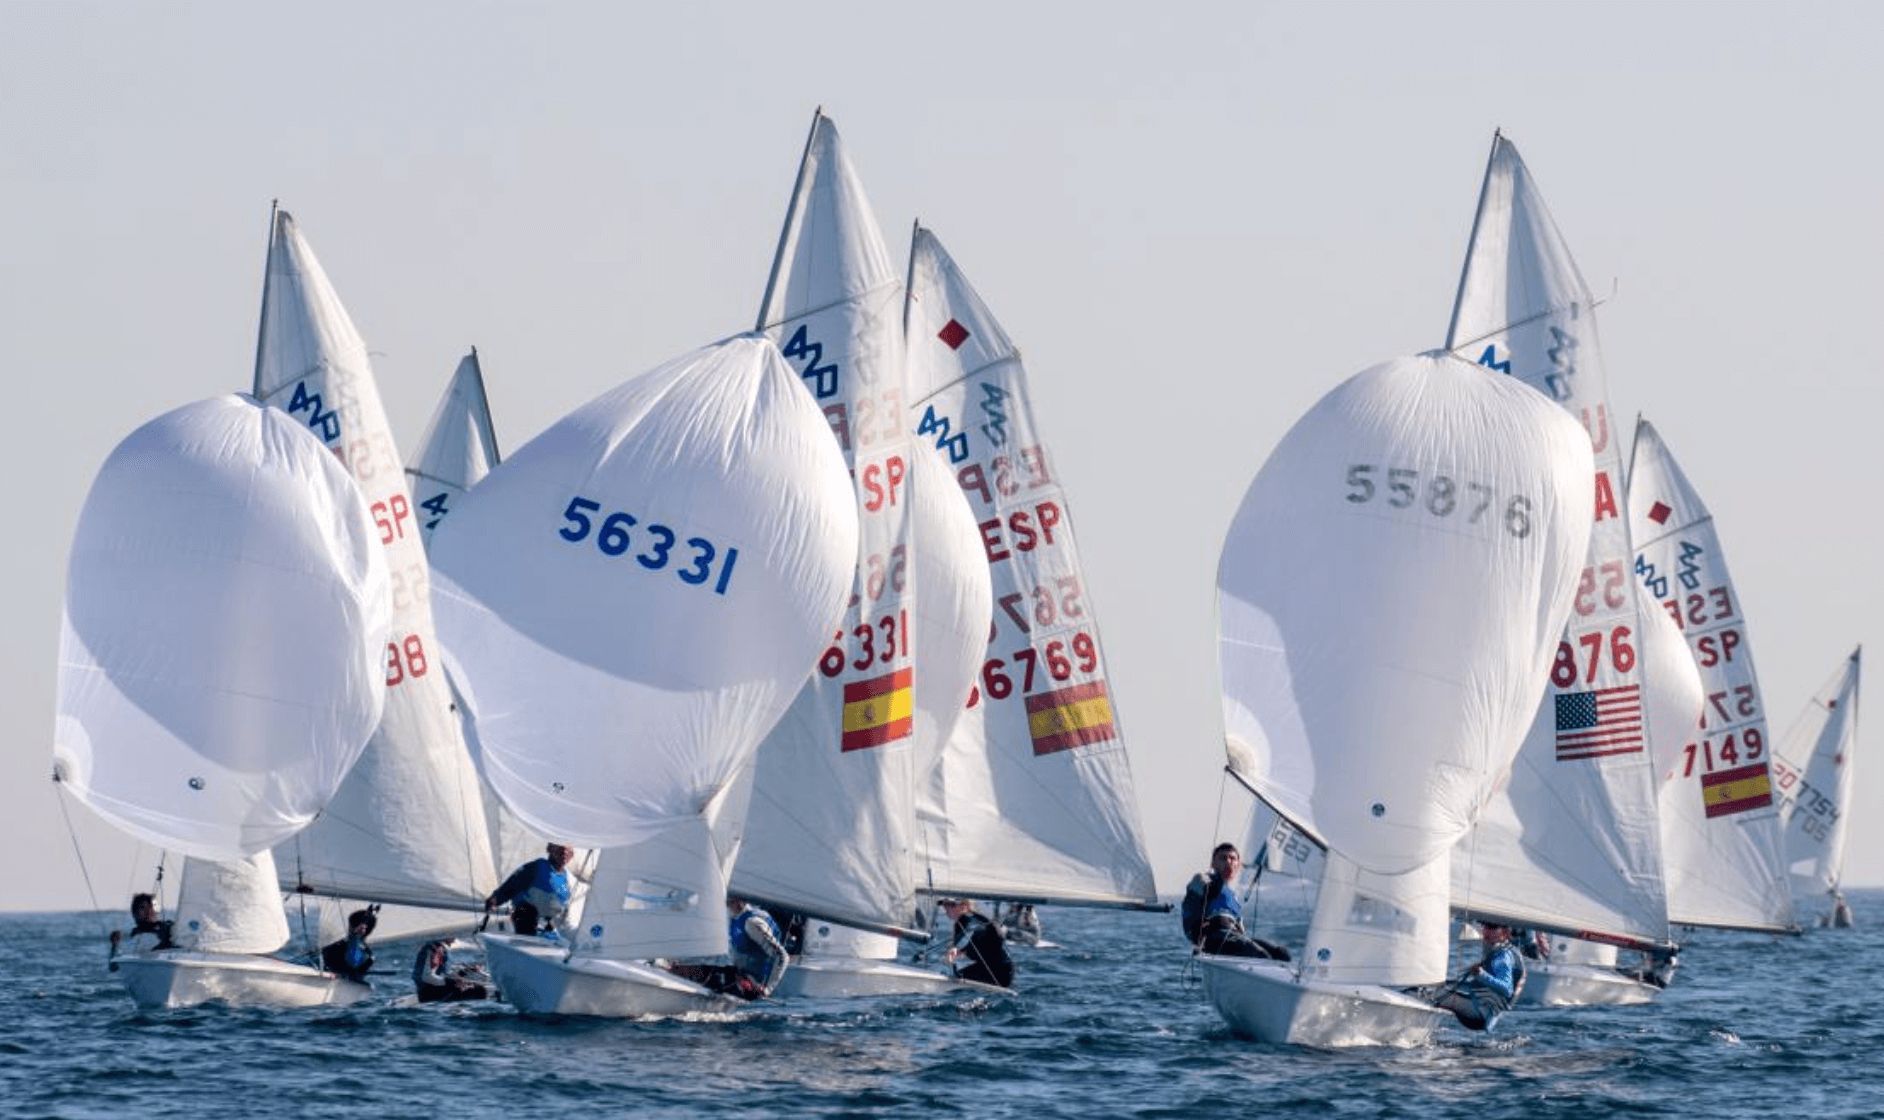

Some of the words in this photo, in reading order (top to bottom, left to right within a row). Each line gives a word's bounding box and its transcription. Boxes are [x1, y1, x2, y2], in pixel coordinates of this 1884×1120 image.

[371, 495, 408, 545] SP
[978, 501, 1060, 562] ESP
[1346, 464, 1531, 539] 55876
[559, 496, 739, 596] 56331
[966, 632, 1097, 709] 6769
[1551, 626, 1635, 688] 876
[1697, 630, 1740, 667] SP
[1666, 728, 1762, 780] 7149
